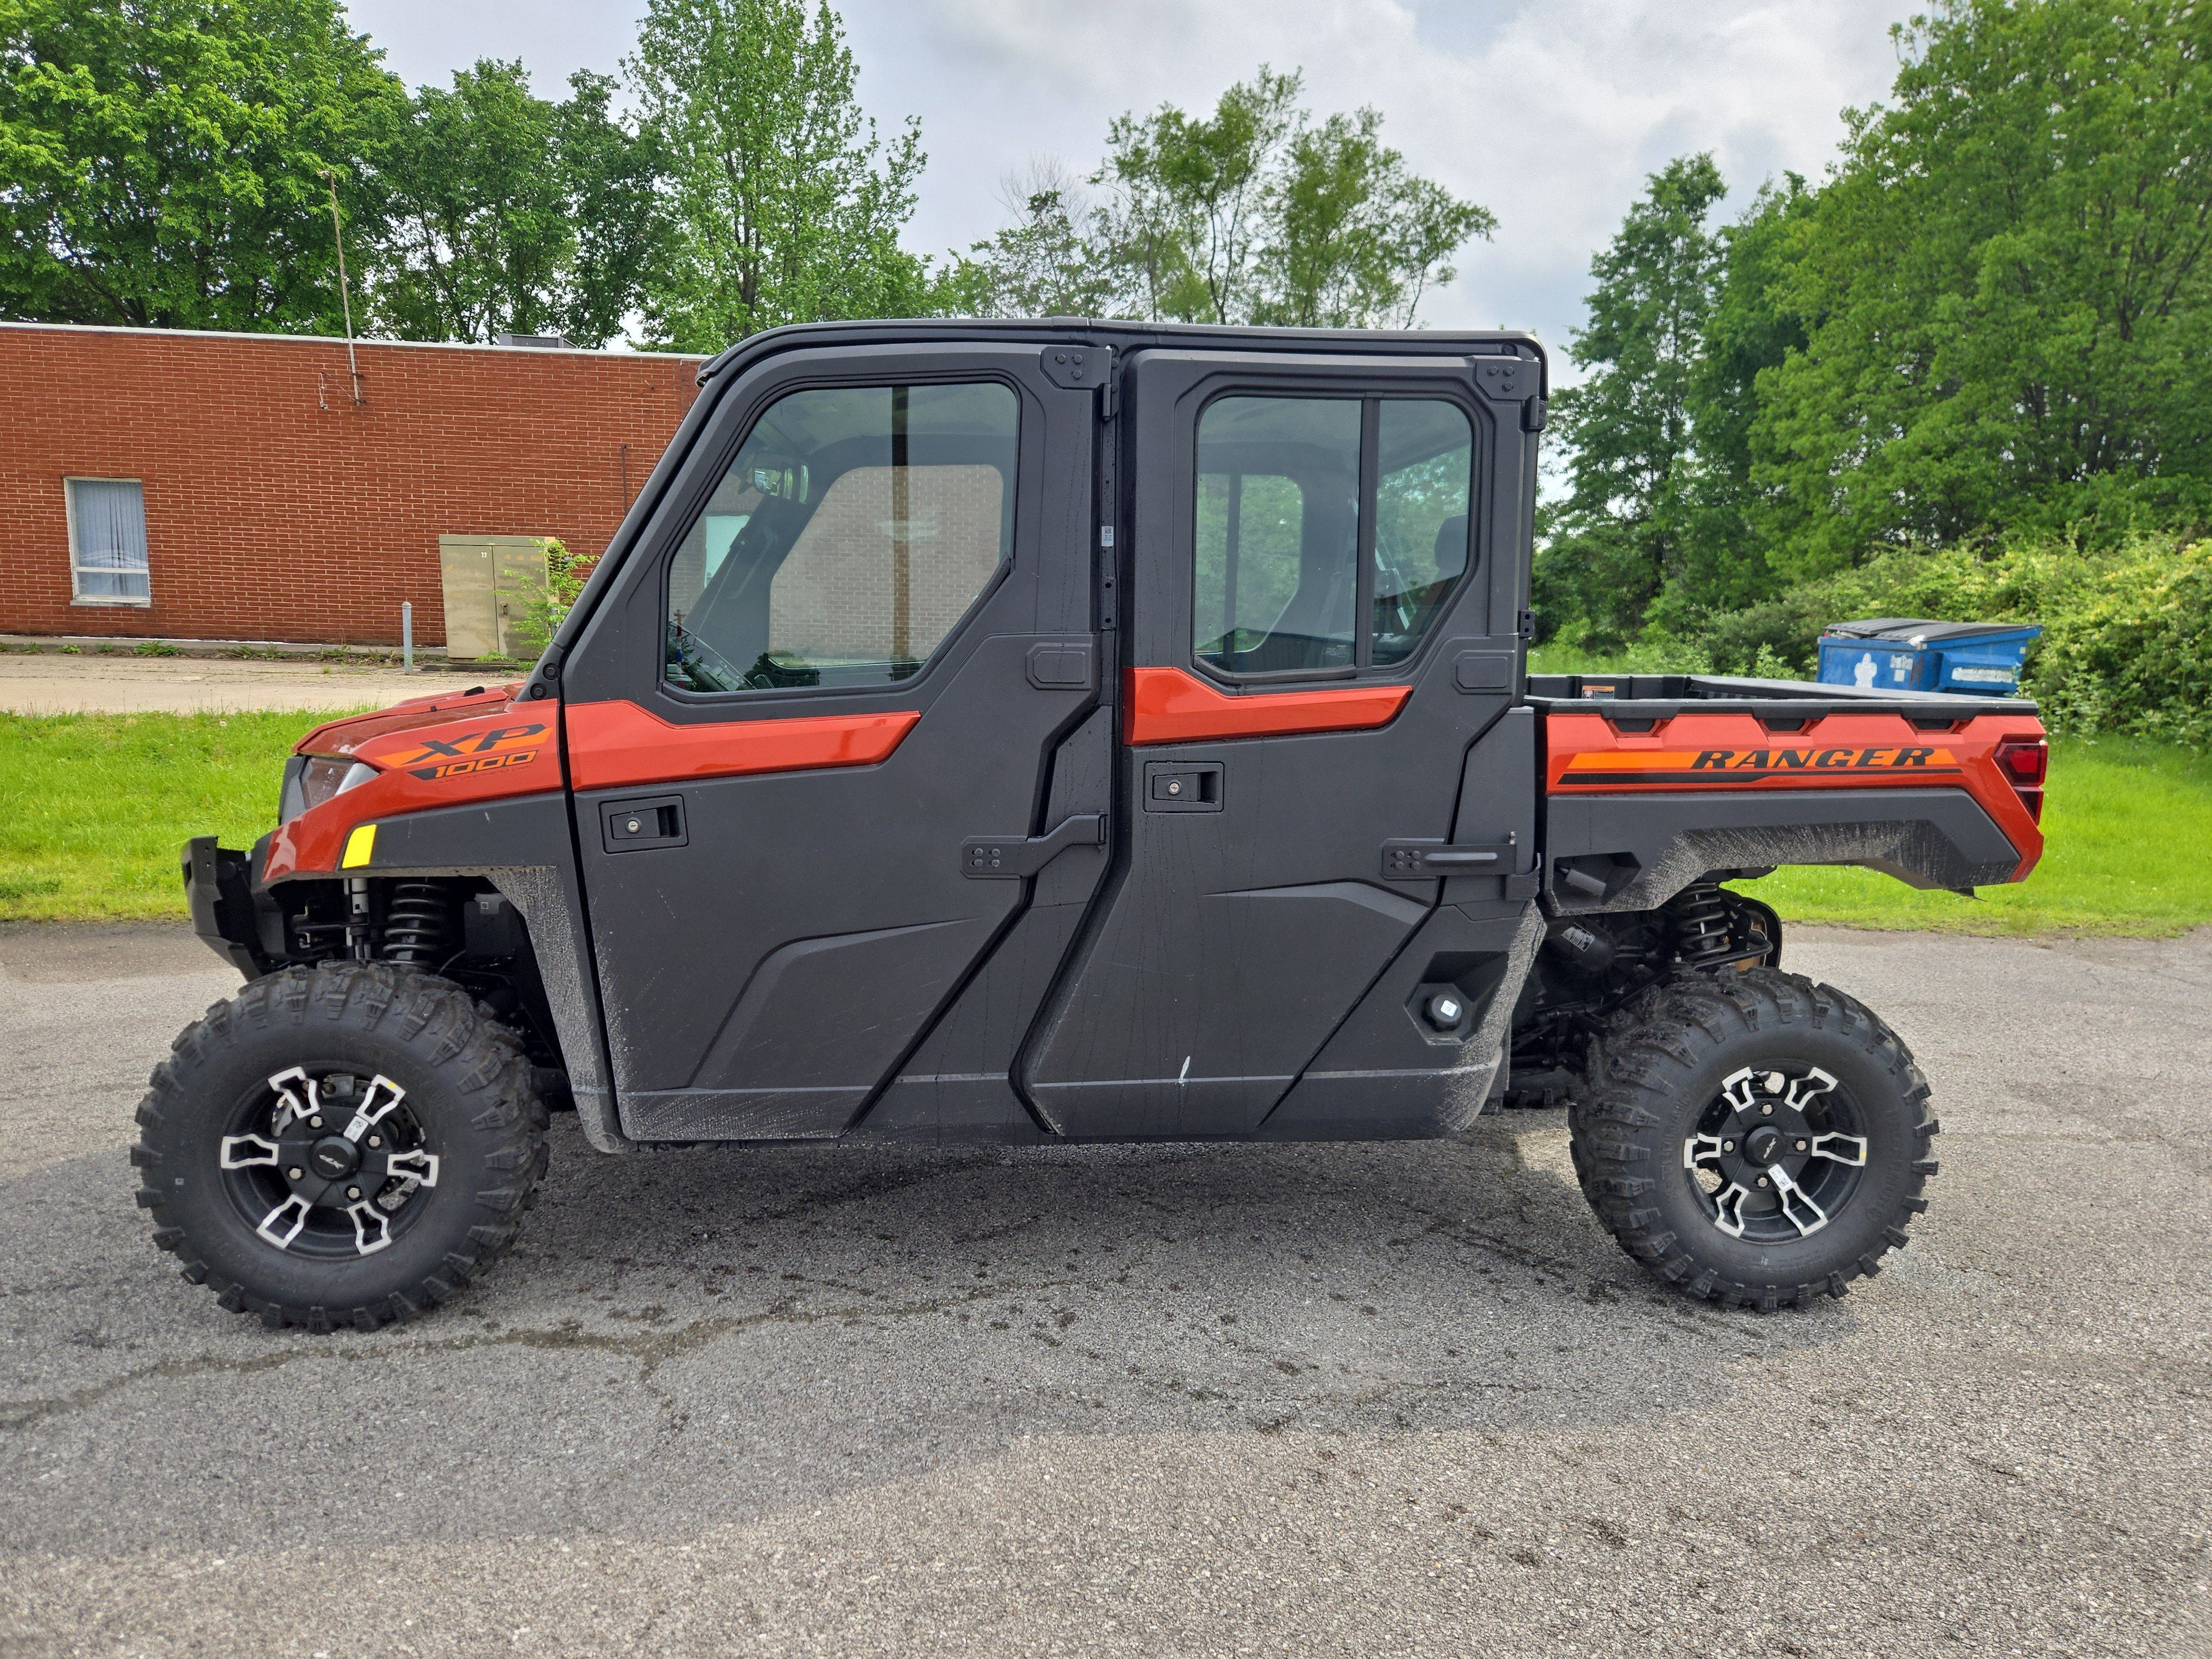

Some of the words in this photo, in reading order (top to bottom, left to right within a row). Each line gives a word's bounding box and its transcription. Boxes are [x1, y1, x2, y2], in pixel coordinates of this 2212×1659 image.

[400, 723, 546, 766] XP
[1689, 748, 1935, 770] RANGER
[434, 750, 537, 779] 1000
